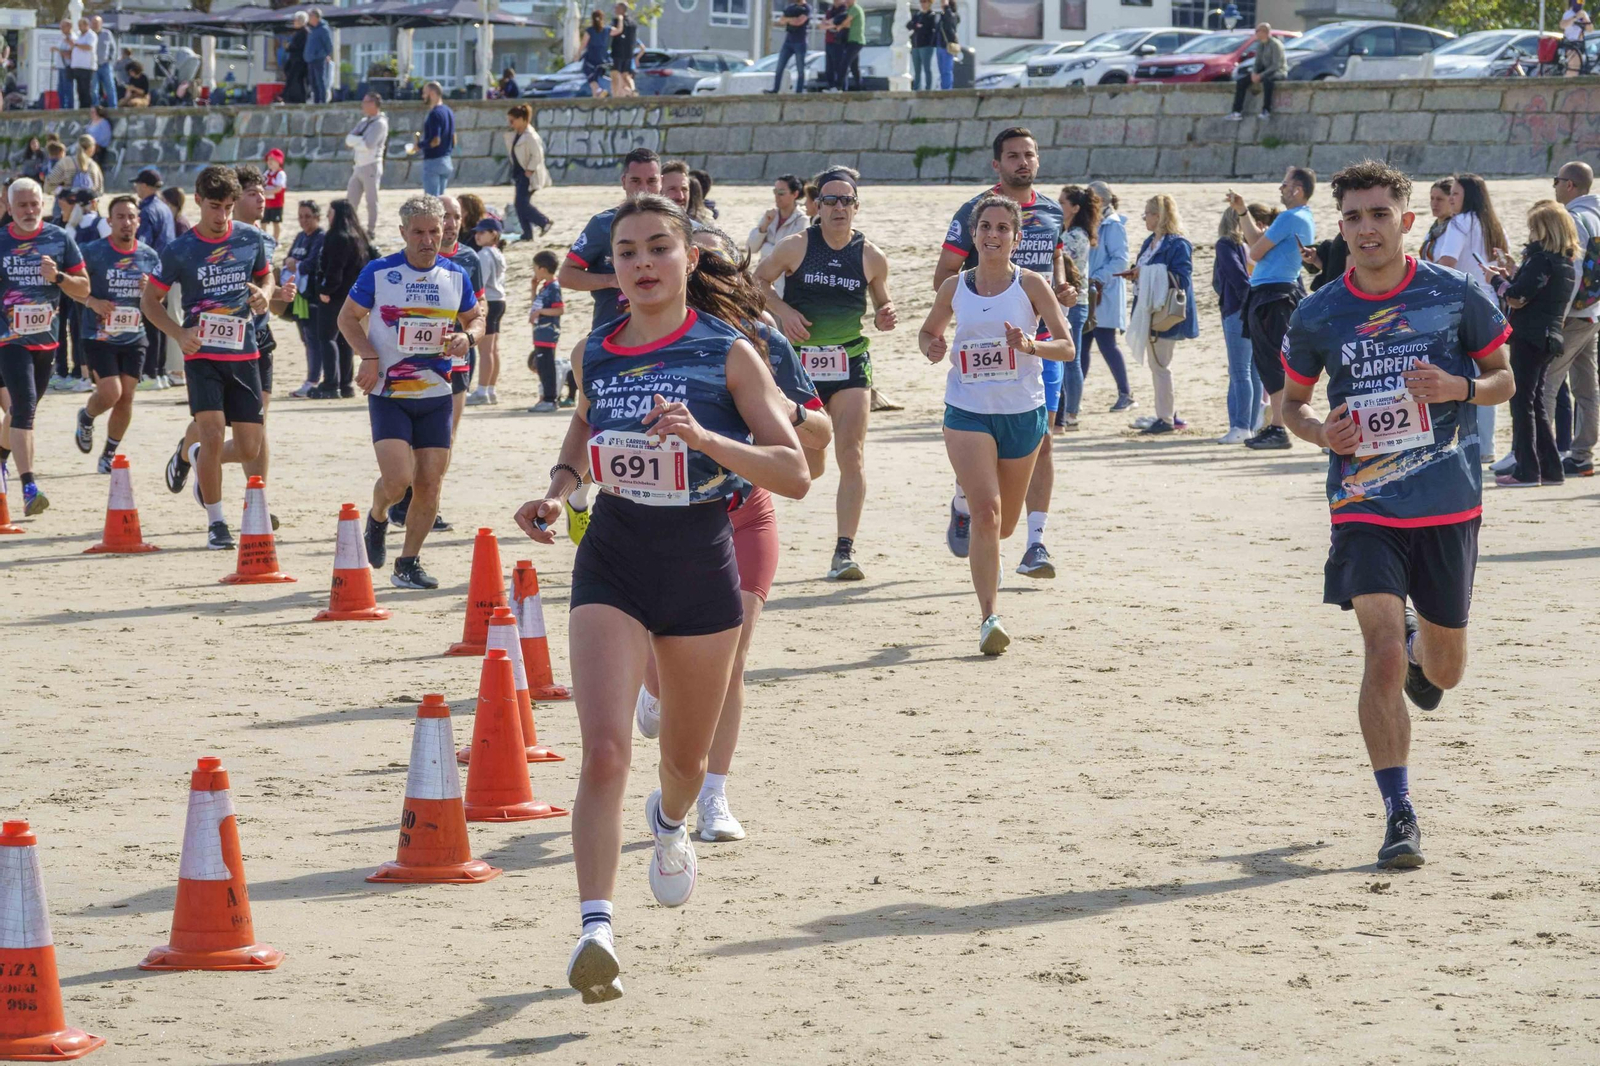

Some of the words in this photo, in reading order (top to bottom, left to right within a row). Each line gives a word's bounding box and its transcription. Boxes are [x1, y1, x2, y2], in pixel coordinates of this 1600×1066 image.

[202, 272, 247, 288] CARREIRA
[406, 282, 439, 290] CARREIRA
[804, 272, 829, 284] máis
[837, 277, 861, 291] auga
[425, 294, 440, 302] 100
[24, 314, 45, 324] 100
[114, 314, 132, 324] 481
[209, 324, 234, 336] 703
[414, 330, 432, 342] 40
[1360, 339, 1386, 358] FE
[1388, 342, 1428, 356] seguros
[811, 356, 836, 368] 991
[972, 352, 1003, 367] 364
[1352, 380, 1382, 390] PRAIA
[596, 397, 624, 409] PRAIA
[610, 408, 624, 418] DE
[1368, 408, 1411, 432] 692
[626, 438, 650, 446] CARREIRA
[610, 454, 659, 480] 691
